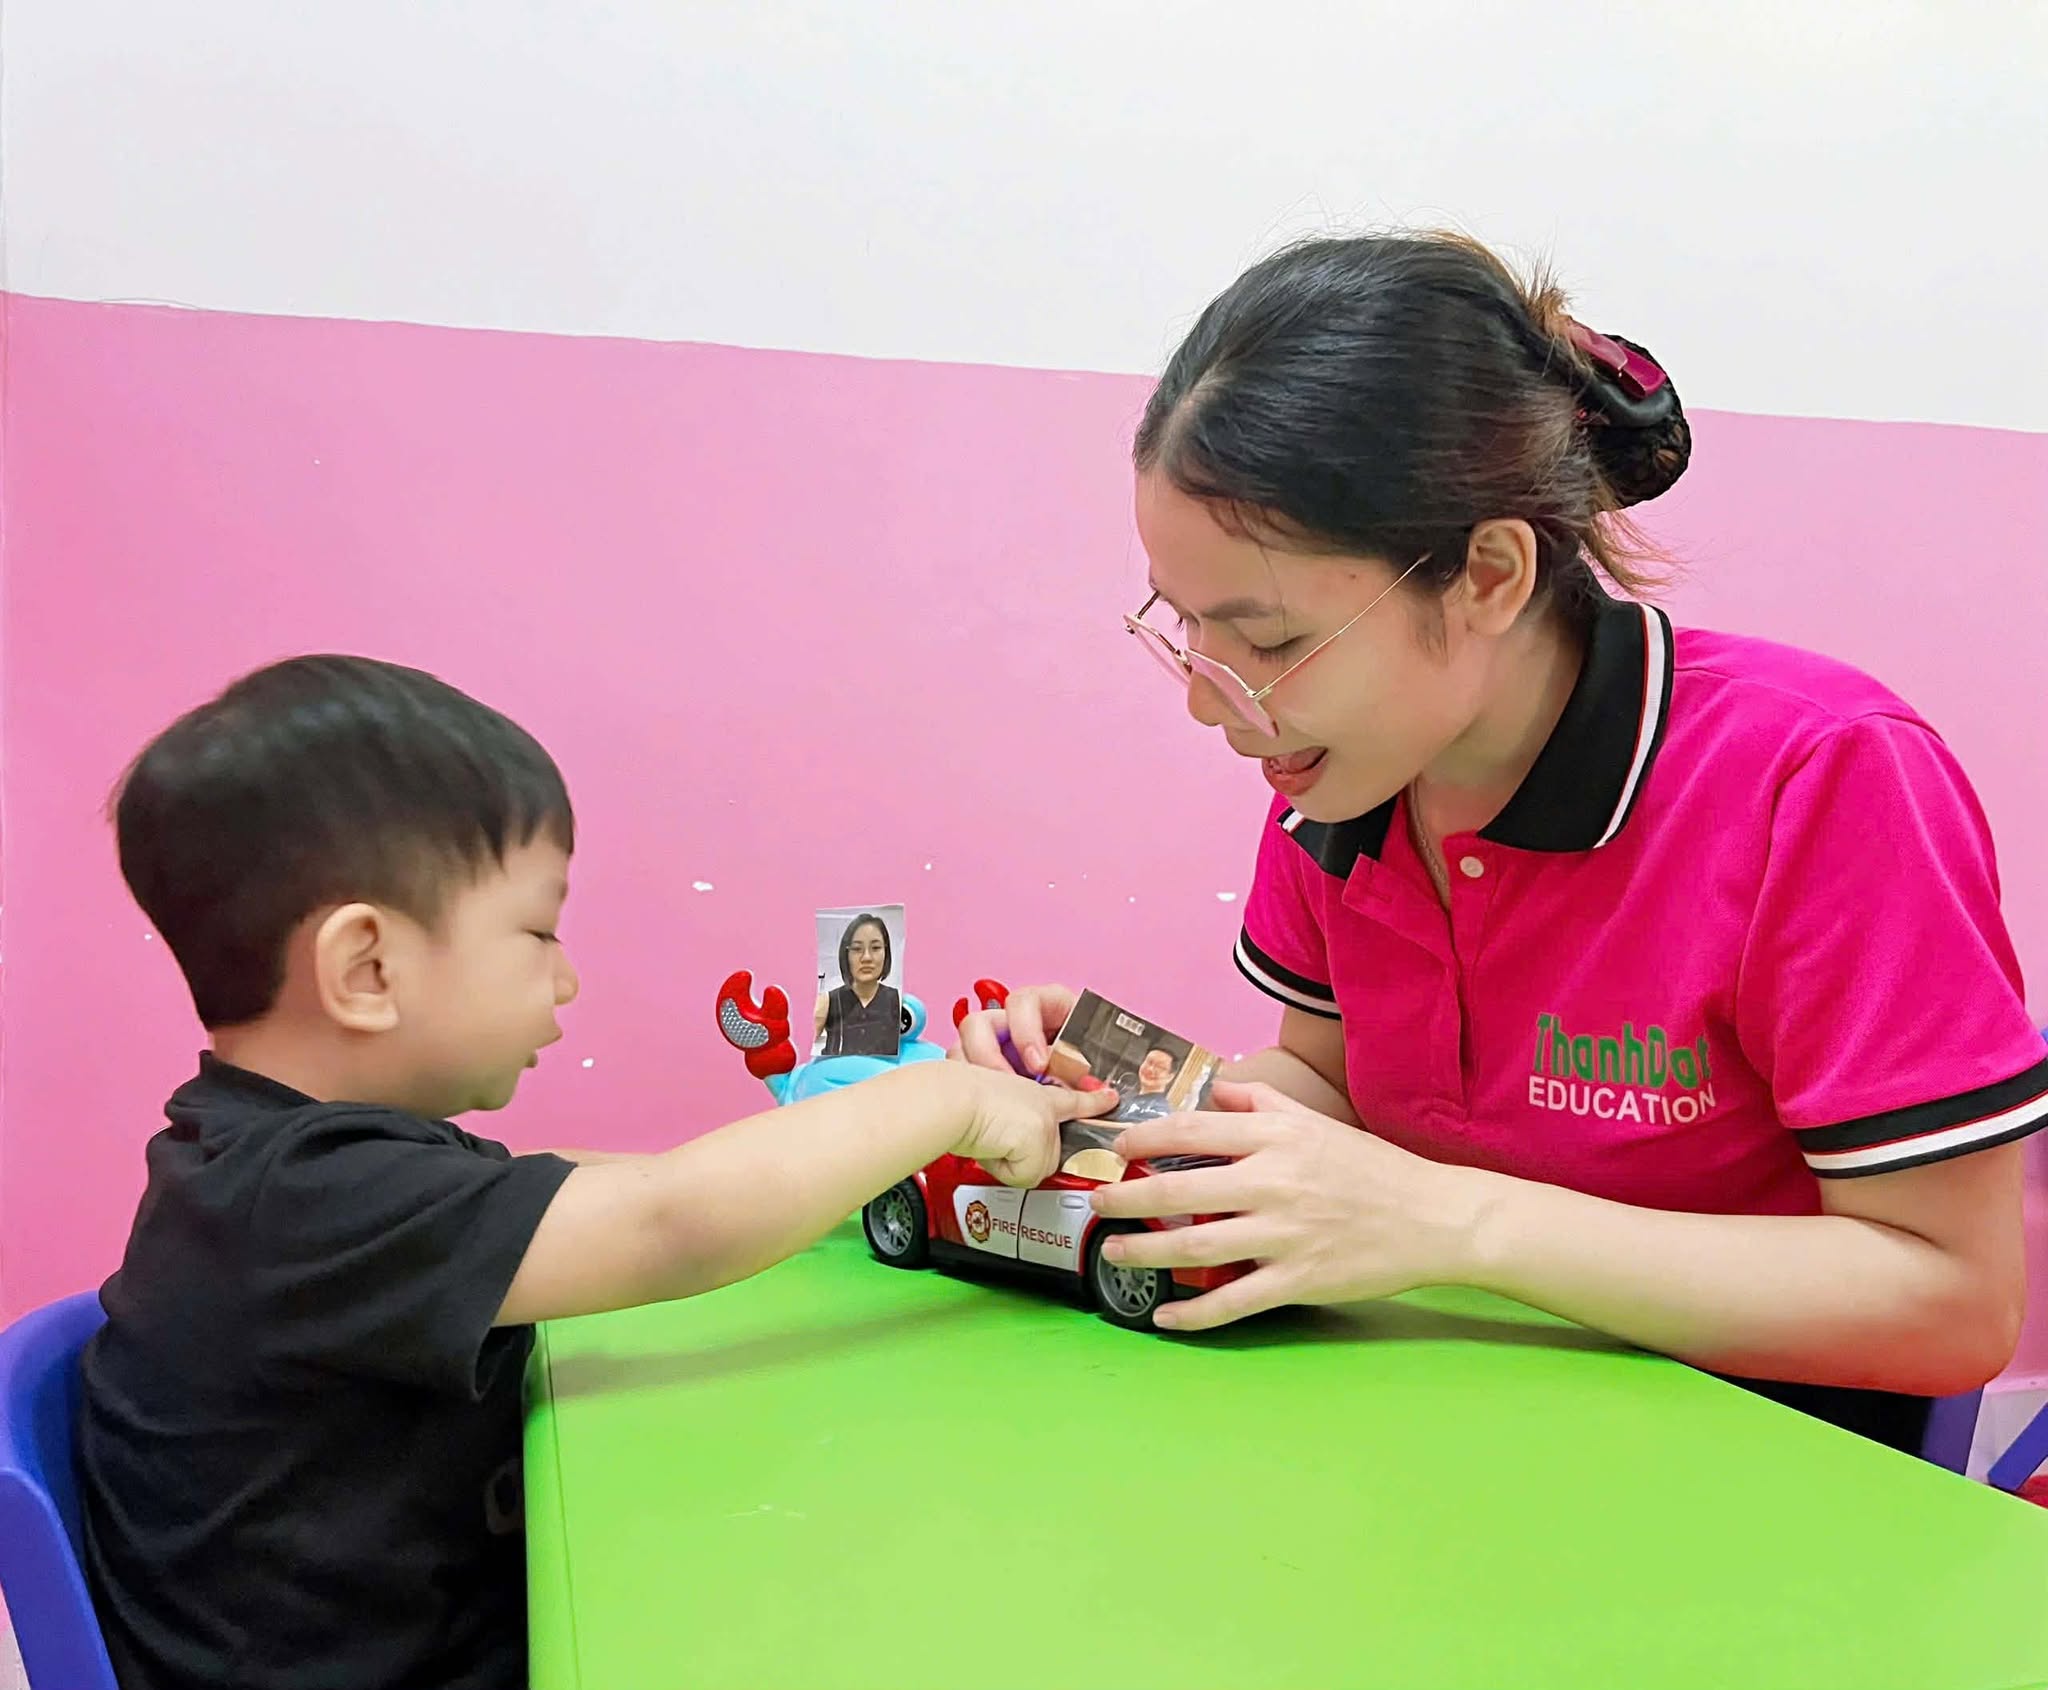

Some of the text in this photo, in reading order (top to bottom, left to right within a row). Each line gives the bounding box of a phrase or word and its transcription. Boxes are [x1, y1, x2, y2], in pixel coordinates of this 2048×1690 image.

[1534, 1012, 1712, 1089] ThanhDat
[1528, 1075, 1716, 1125] EDUCATION
[992, 1218, 1073, 1249] FIRE RESCUE
